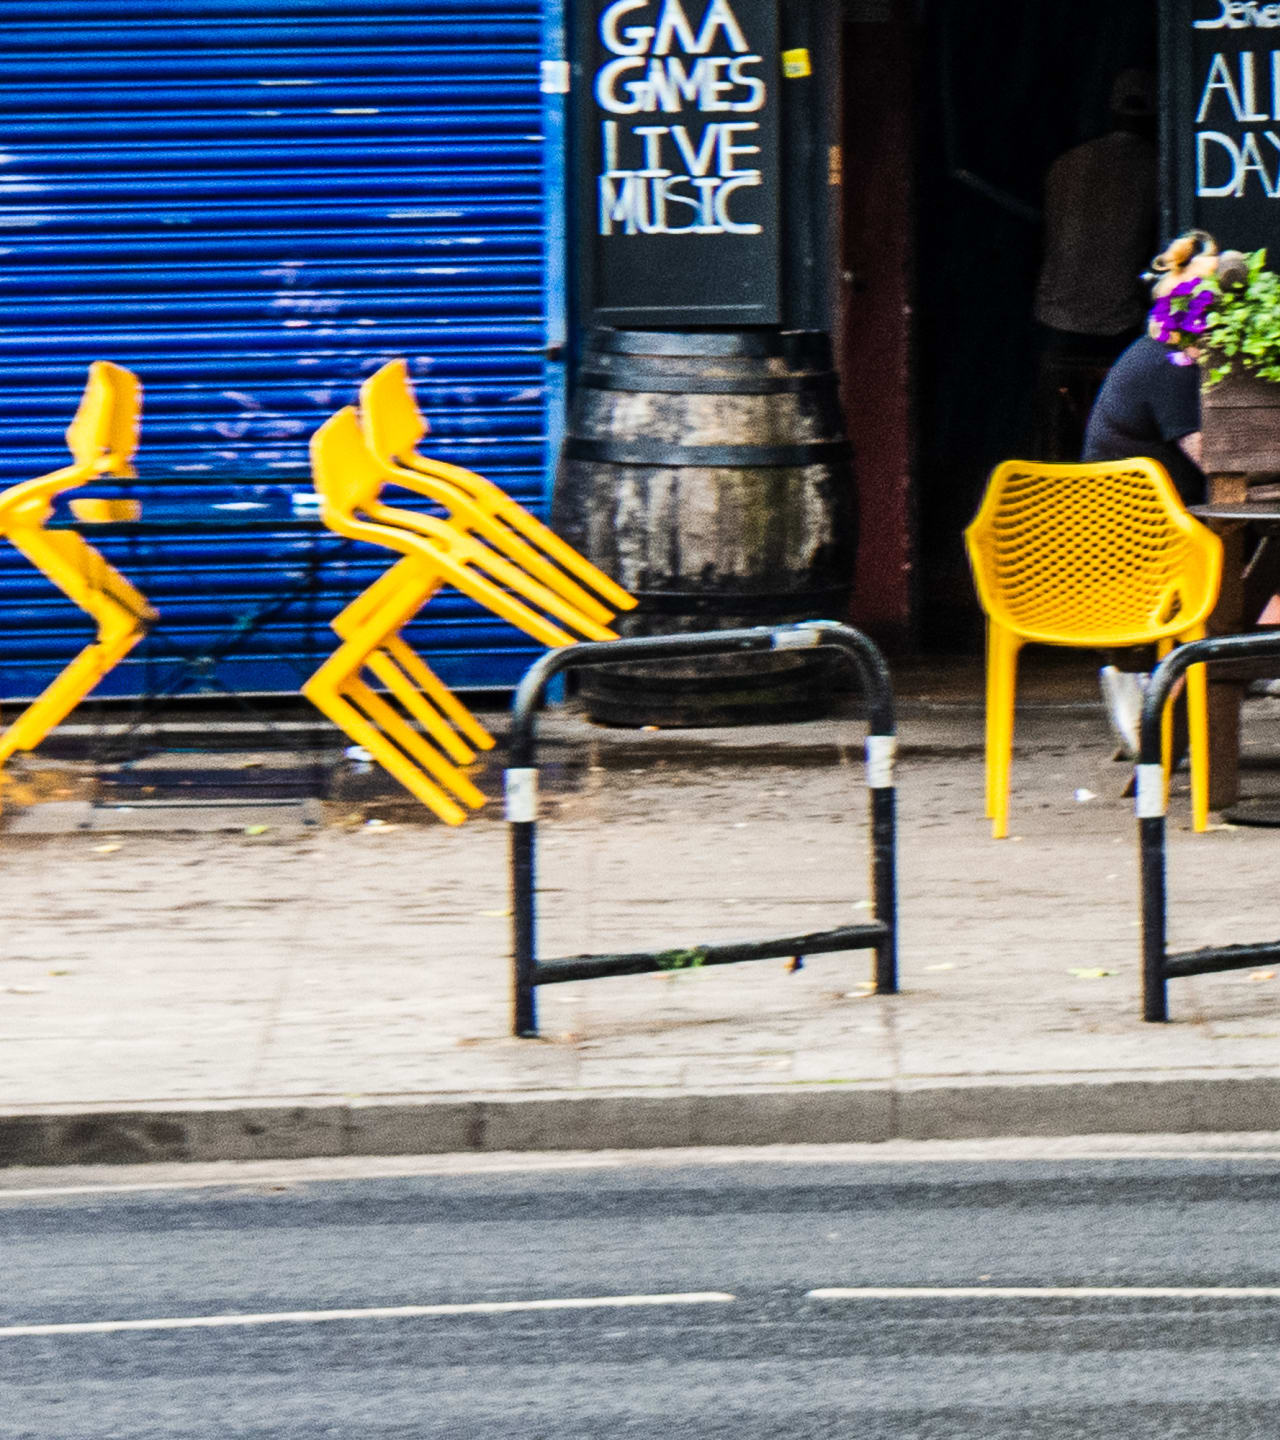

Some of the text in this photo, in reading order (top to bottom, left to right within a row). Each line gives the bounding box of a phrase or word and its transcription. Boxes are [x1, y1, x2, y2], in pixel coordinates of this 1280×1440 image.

[593, 55, 766, 115] GAMES
[601, 119, 762, 178] LIVE
[596, 174, 764, 237] MUSIC
